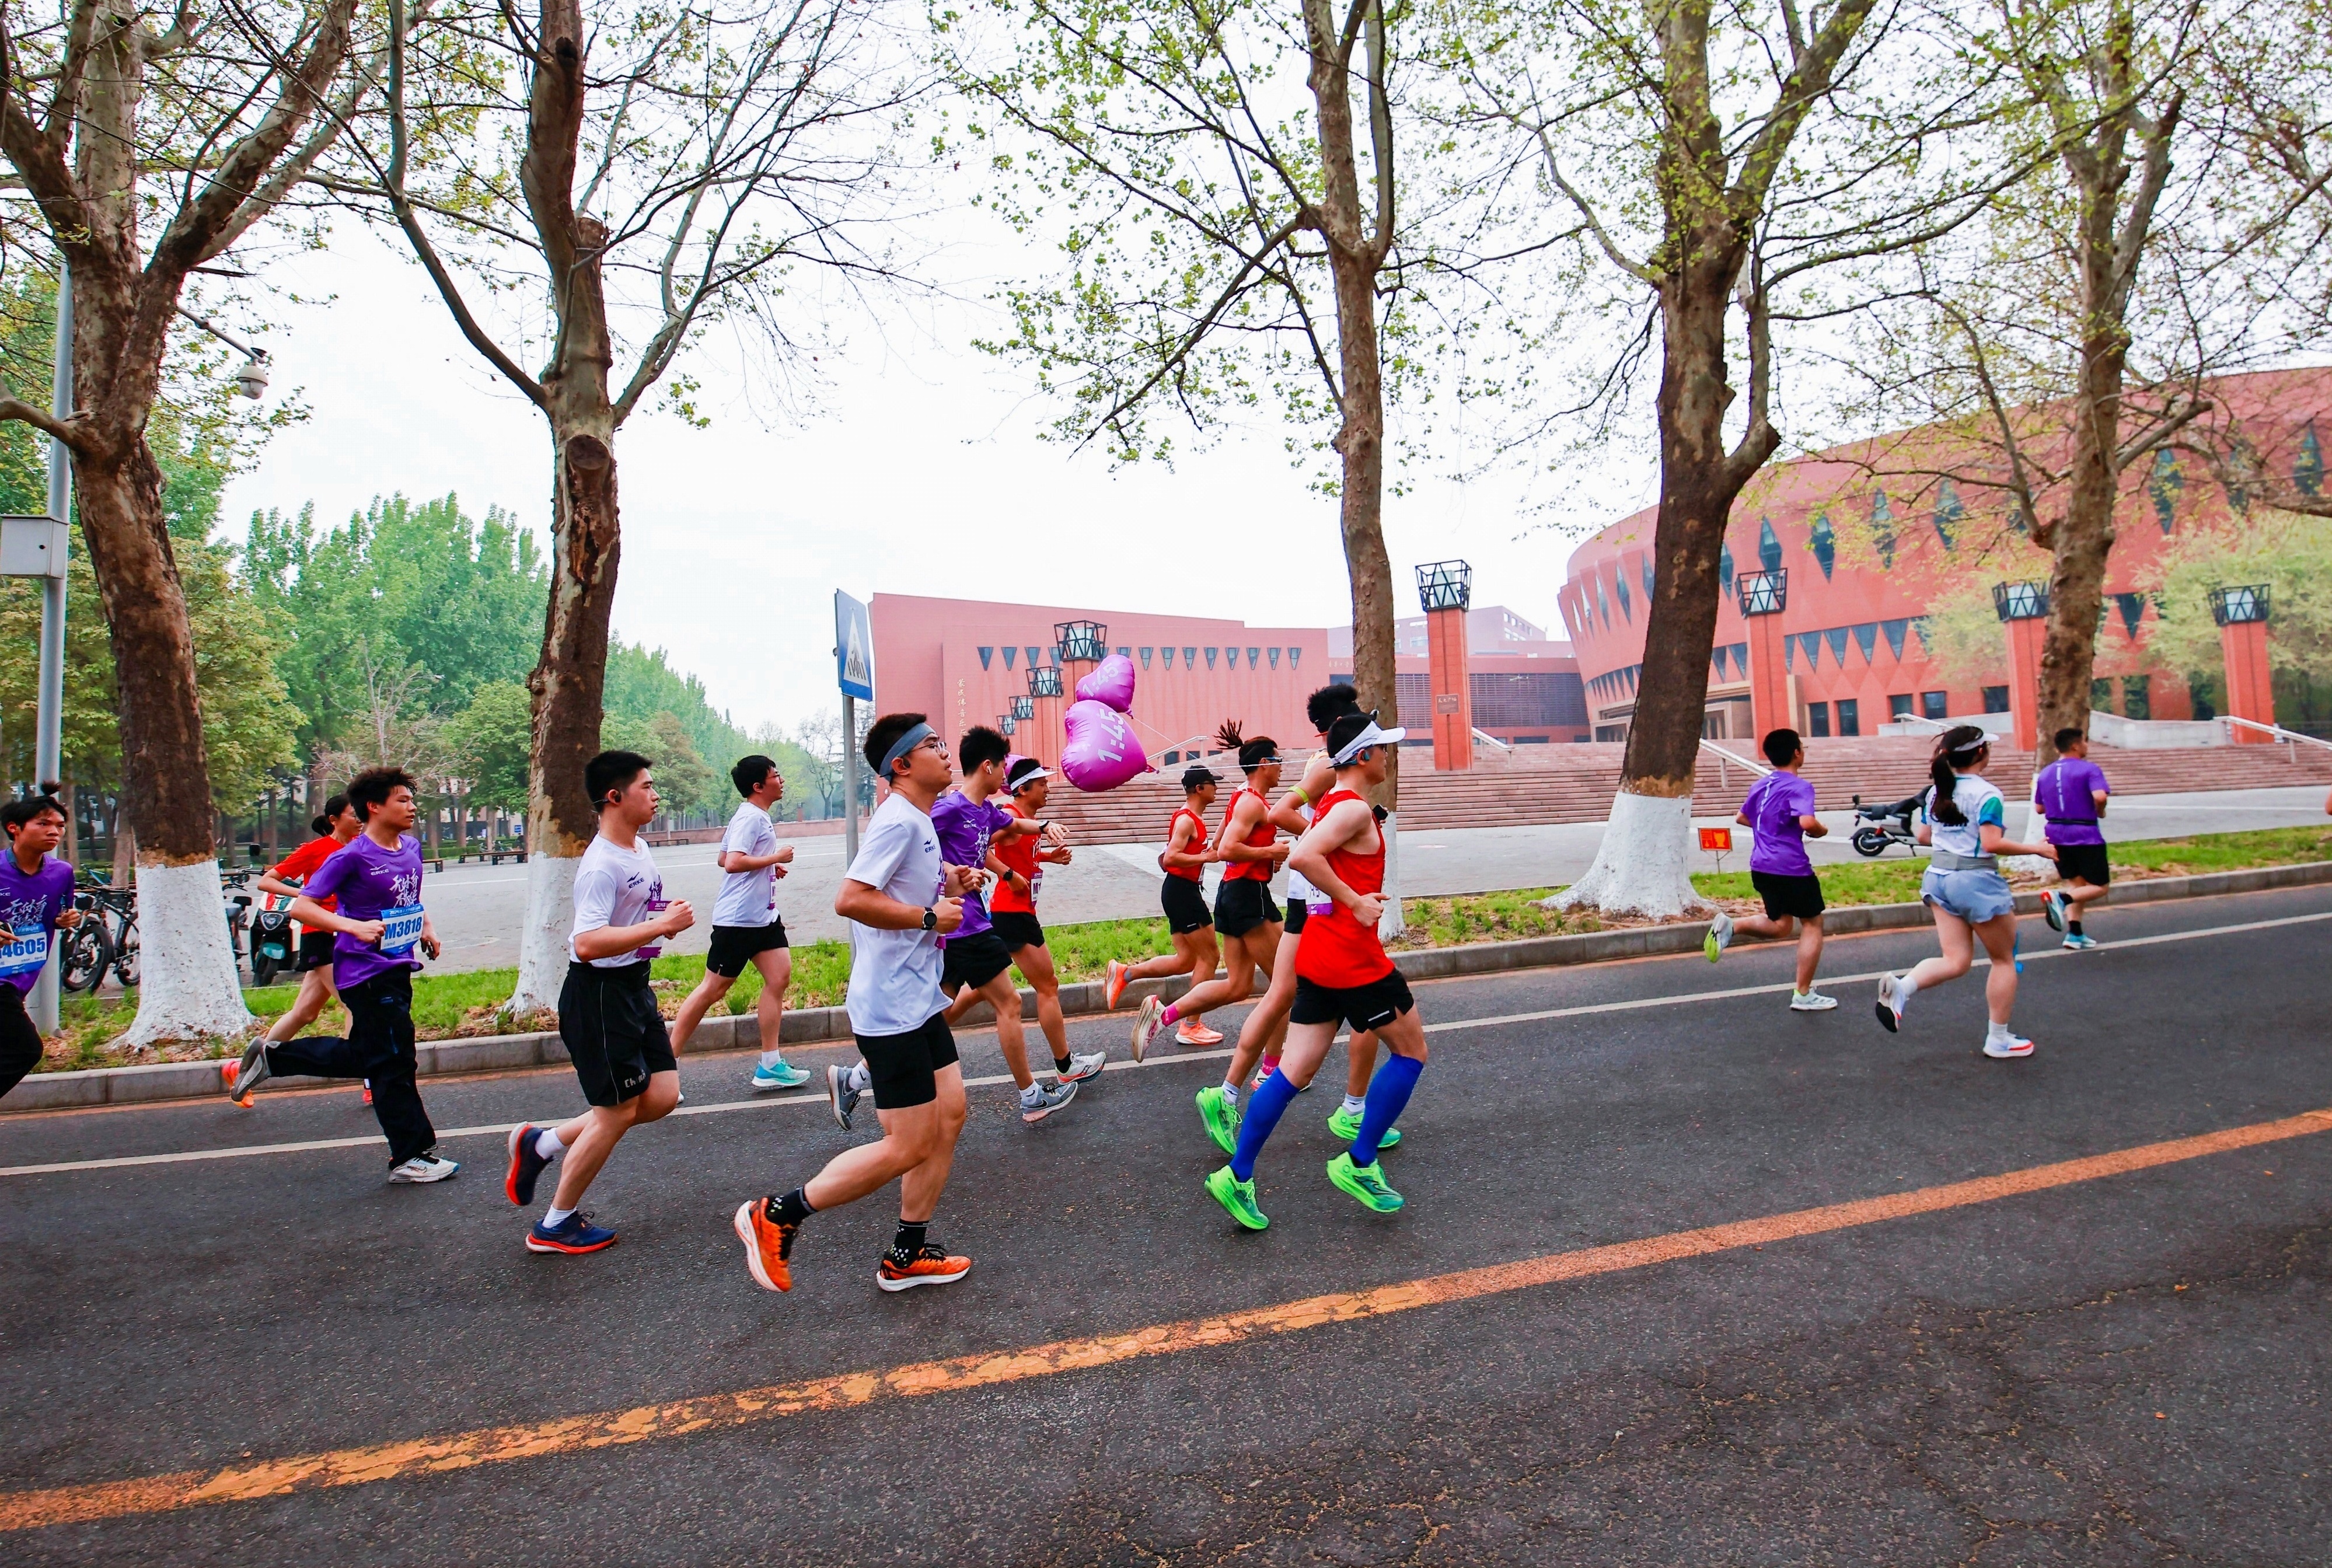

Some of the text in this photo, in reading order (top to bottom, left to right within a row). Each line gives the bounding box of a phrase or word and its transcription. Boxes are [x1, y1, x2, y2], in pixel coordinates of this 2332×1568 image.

[1082, 662, 1119, 697] 1:45
[1097, 708, 1127, 762] 1:45
[629, 877, 645, 889] ERKE
[385, 917, 423, 940] M3818
[0, 938, 45, 959] 4605
